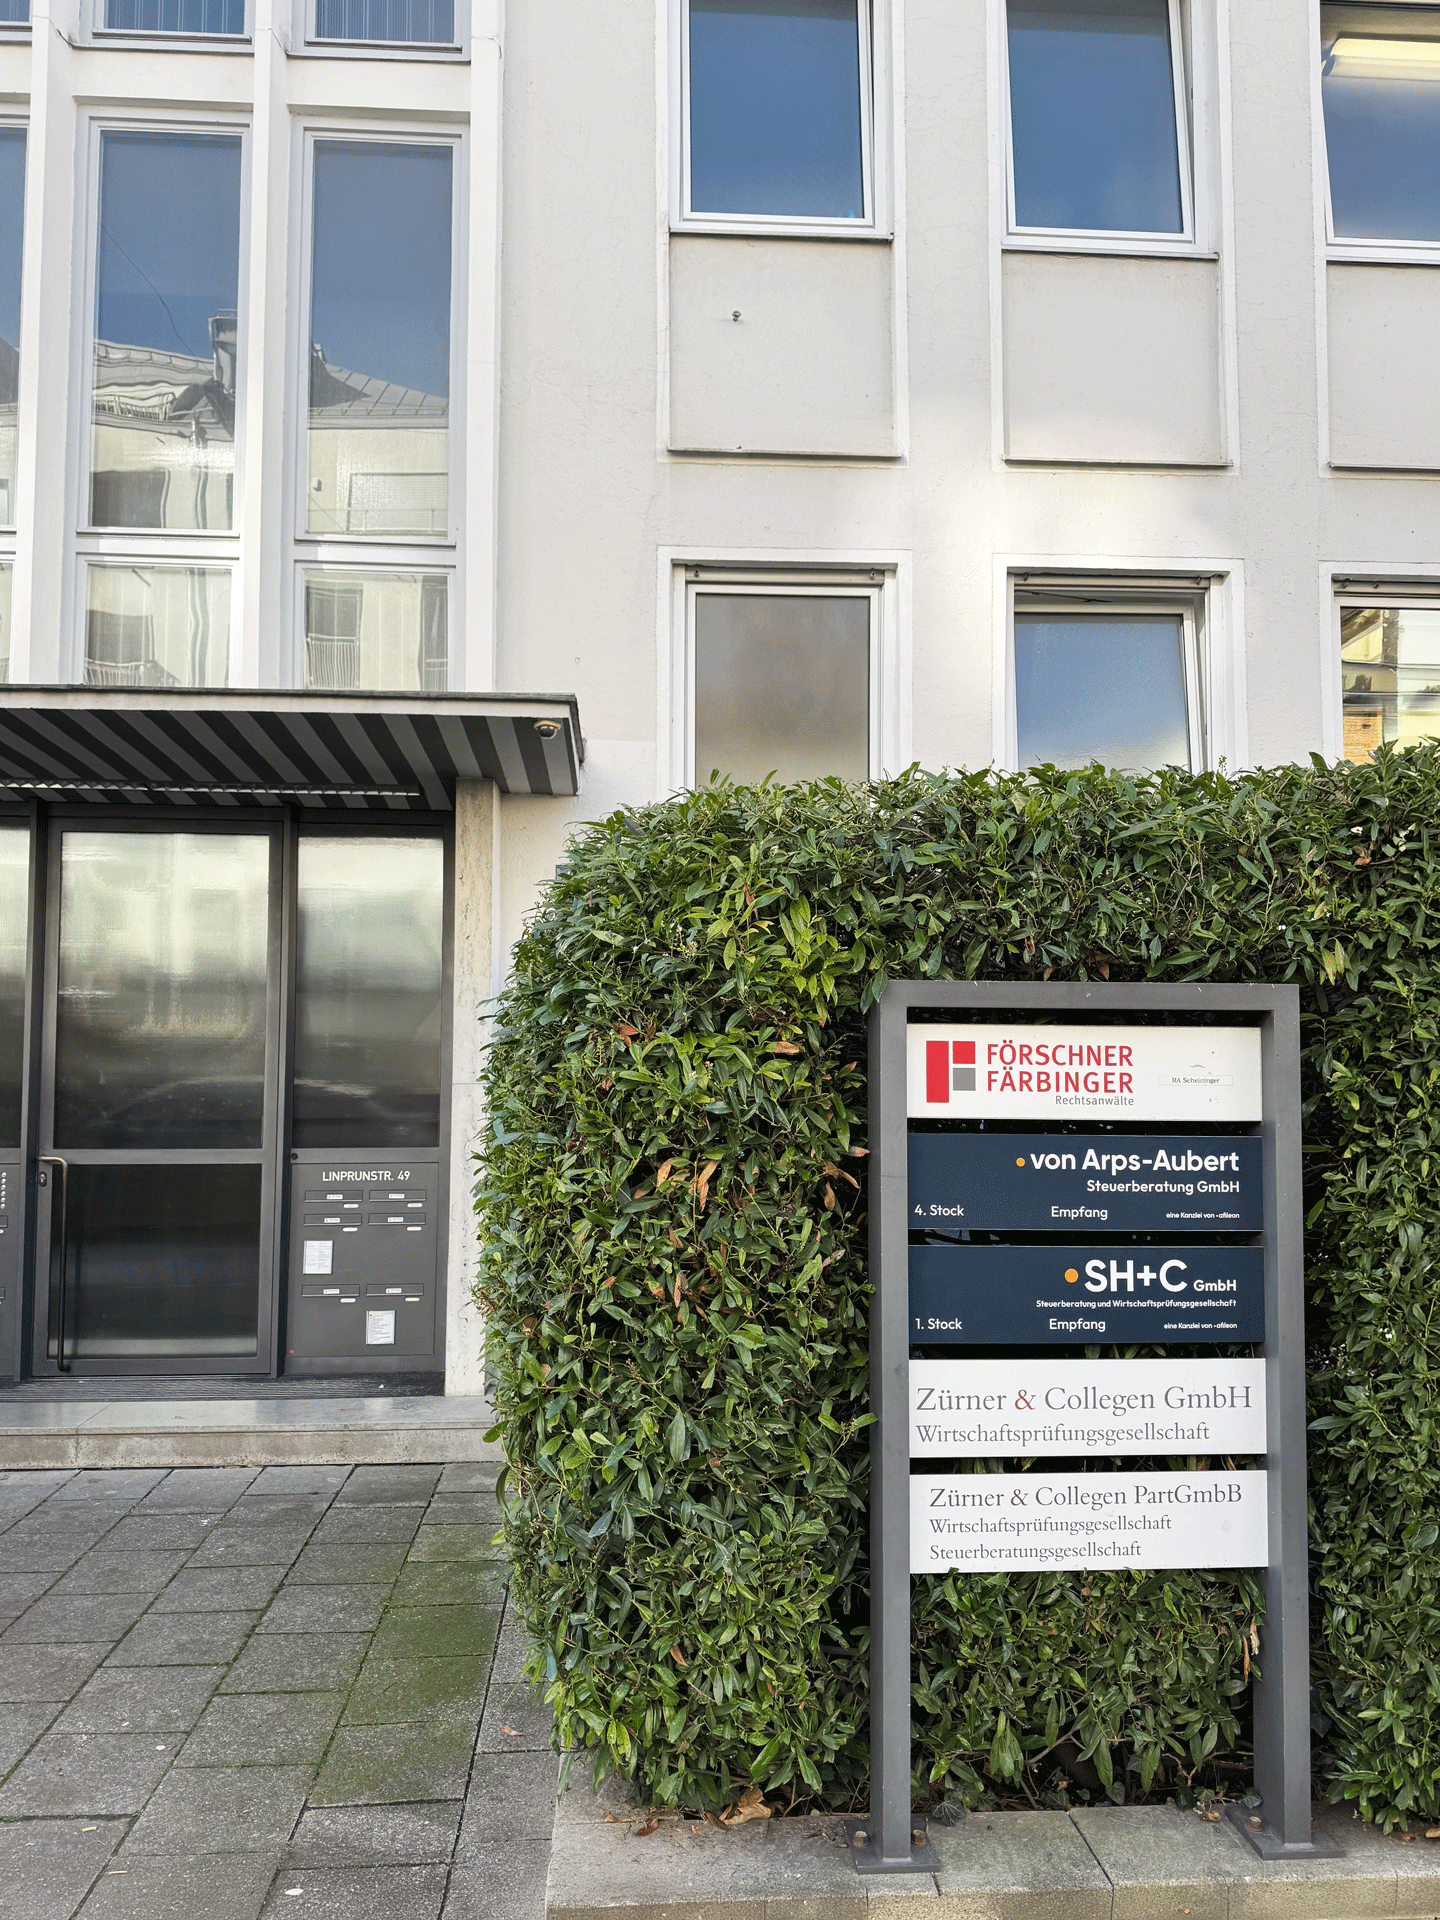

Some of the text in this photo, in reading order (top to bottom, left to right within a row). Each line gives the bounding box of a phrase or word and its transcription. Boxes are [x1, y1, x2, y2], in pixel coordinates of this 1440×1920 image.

[987, 1039, 1134, 1067] FÖRSCHNER
[987, 1066, 1134, 1094] FÄRBINGER
[1055, 1095, 1134, 1107] Rechtsanwälte
[1030, 1149, 1240, 1176] von Arps-Aubert
[322, 1171, 411, 1182] LINPRUNSTR. 49
[1086, 1179, 1240, 1195] Steuerberatung GmbH
[914, 1204, 965, 1217] 4. Stock
[1051, 1206, 1108, 1221] Empfang
[1084, 1259, 1237, 1293] SH+C GmbH
[1036, 1299, 1237, 1310] Steuerberatung und Wirtschaftsprüfungsgesellschaft
[915, 1317, 963, 1330] 1. Stock
[1049, 1318, 1106, 1332] Empfang
[916, 1385, 1253, 1416] Zürner & Collegen GmbH
[915, 1422, 1211, 1447] Wirtschaftsprüfungsgesellschaft
[929, 1483, 1243, 1511] Zürner & Collegen PartGmbB
[929, 1514, 1173, 1537] Wirtschaftsprüfungsgesellschaft
[929, 1541, 1142, 1562] Steuerberatungsgesellschaft
